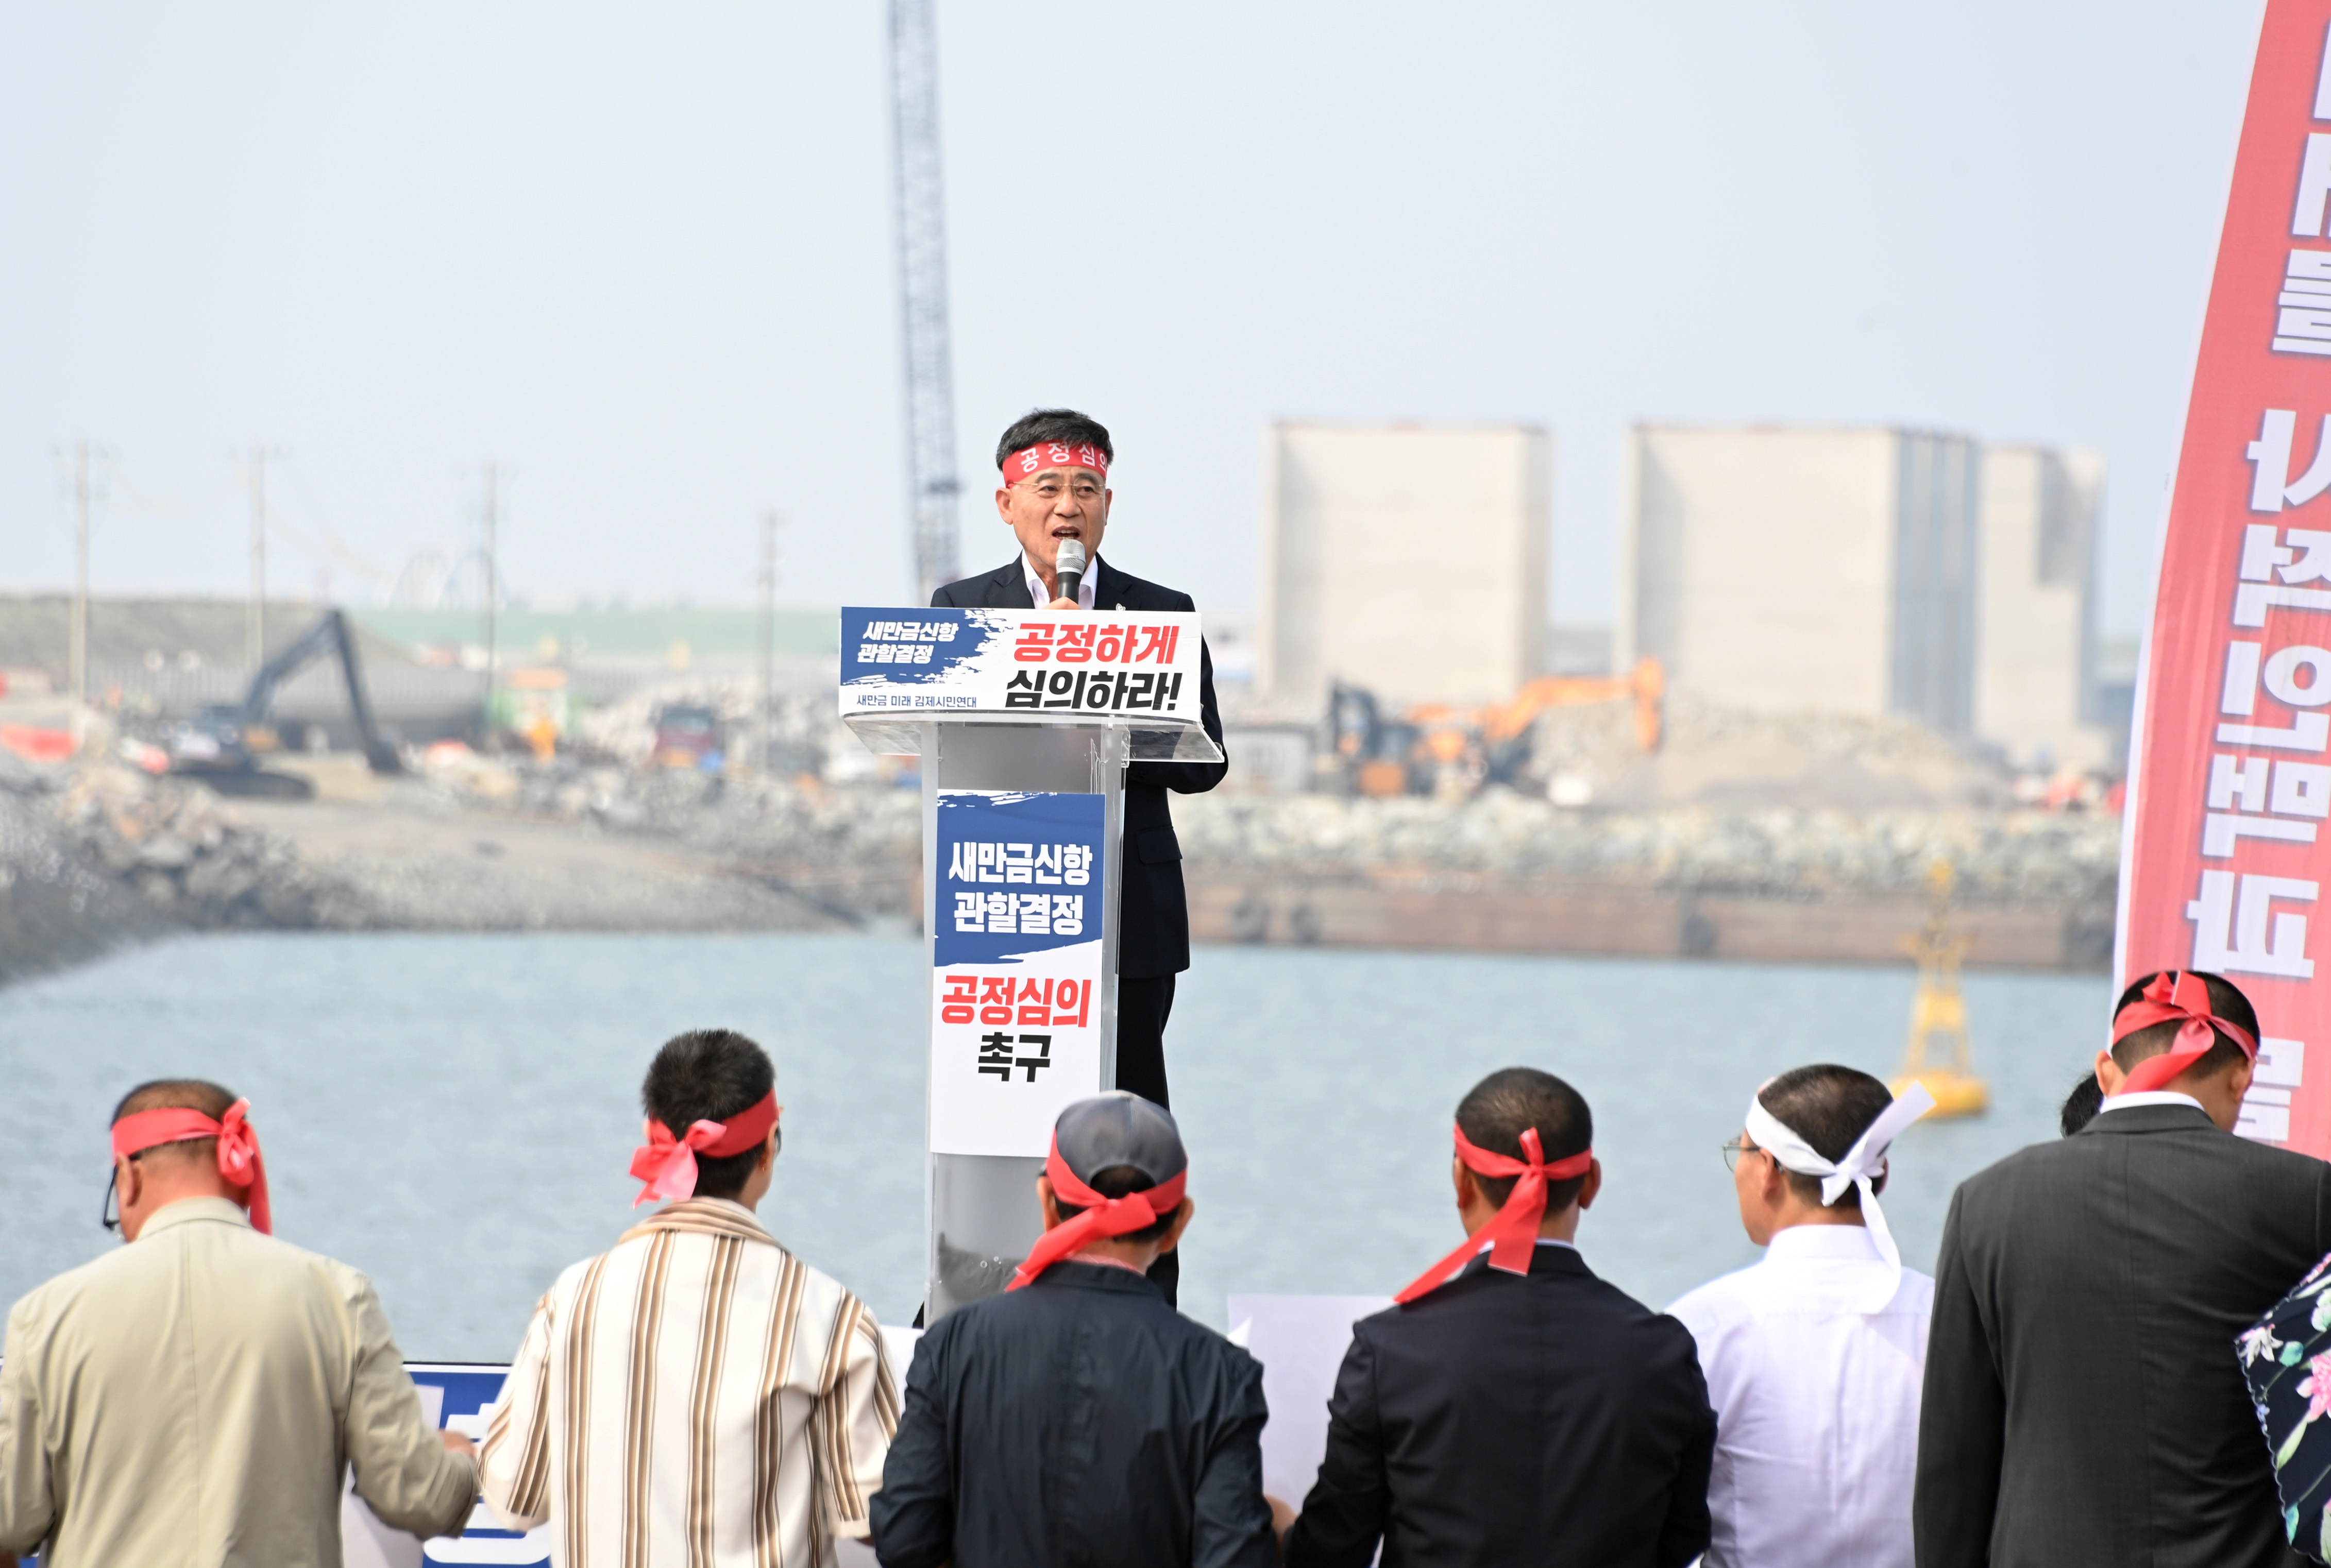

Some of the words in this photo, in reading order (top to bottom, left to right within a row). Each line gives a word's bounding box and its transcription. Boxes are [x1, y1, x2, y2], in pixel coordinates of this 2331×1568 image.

[863, 621, 959, 642] 새만금신항
[1014, 623, 1180, 664] 공정하게
[857, 643, 934, 664] 관할결정
[856, 695, 887, 706] 새만금
[891, 695, 911, 707] 미래
[915, 696, 976, 708] 김제시민연대
[1005, 670, 1183, 711] 심의하라!
[949, 842, 1093, 886] 새만금신항
[954, 892, 1083, 935] 관할결정
[941, 975, 1091, 1028] 공정심의
[978, 1032, 1052, 1083] 촉구
